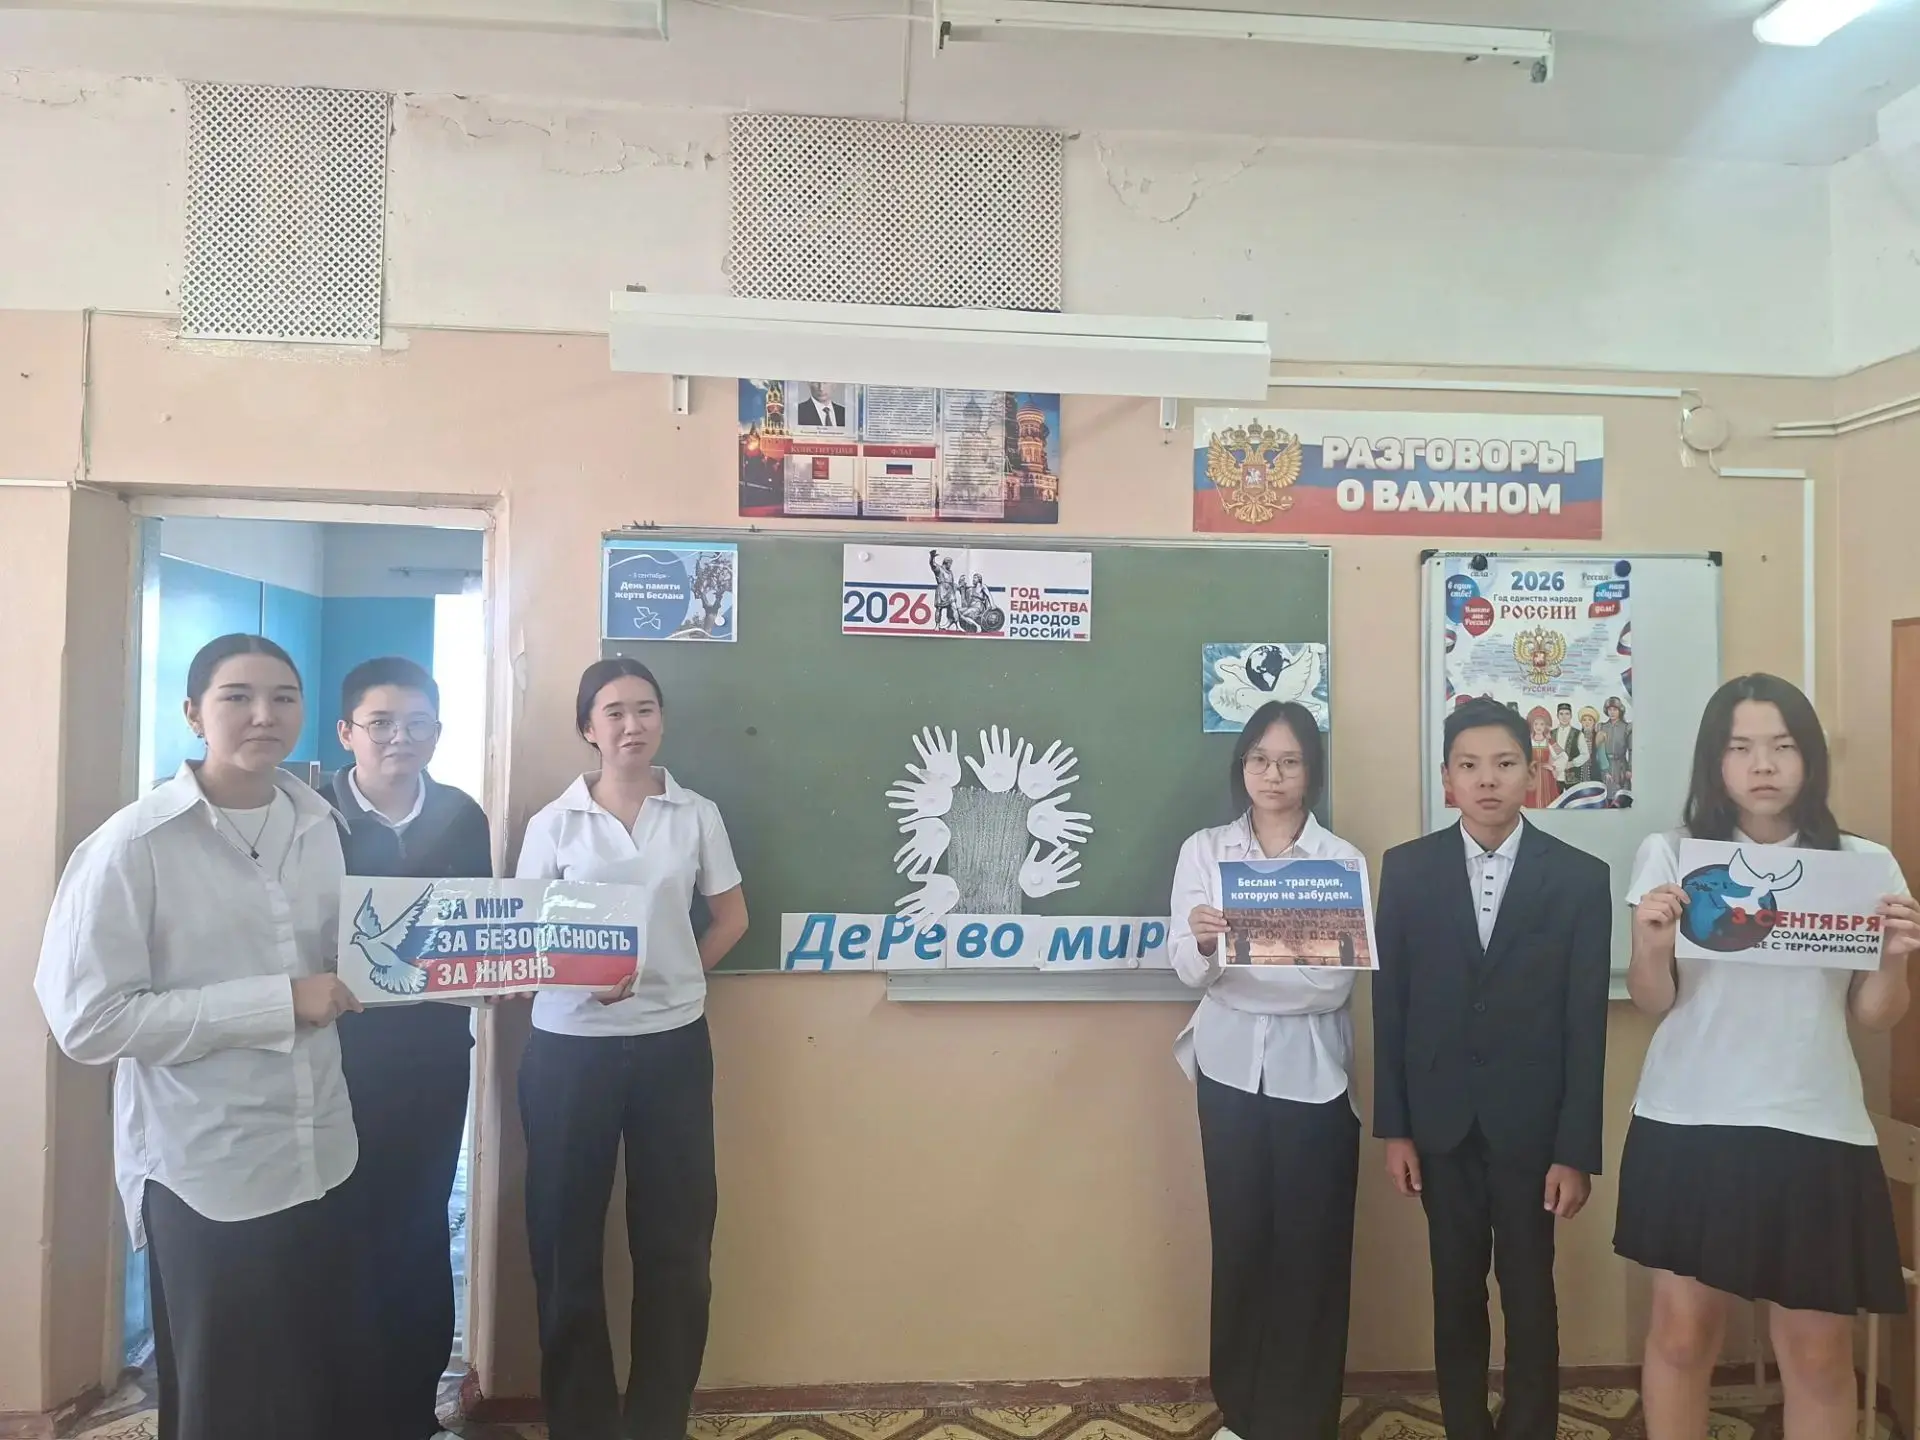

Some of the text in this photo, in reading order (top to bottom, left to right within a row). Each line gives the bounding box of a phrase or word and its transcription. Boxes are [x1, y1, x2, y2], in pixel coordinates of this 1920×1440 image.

[1321, 436, 1576, 474] РАЗГОВОРЫ
[1336, 479, 1561, 515] О ВАЖНОМ
[620, 581, 681, 591] День памяти
[1511, 571, 1565, 591] 2026
[614, 591, 684, 601] жертв Беслана
[1010, 587, 1040, 601] ГОД
[1493, 594, 1508, 602] Год
[843, 591, 932, 625] 2026
[1010, 600, 1088, 613] ЕДИНСТВА
[1500, 604, 1577, 620] РОССИИ
[1009, 614, 1081, 626] НАРОДОВ
[1009, 626, 1071, 639] РОССИИ
[1237, 878, 1276, 887] Беслан
[1285, 878, 1343, 889] трагедия,
[1231, 890, 1353, 902] которую не забудем.
[437, 897, 524, 920] ЗА МИР
[1731, 906, 1881, 932] 3 СЕНТЯБРЯ
[437, 925, 631, 953] ЗА БЕЗОПАСНОСТЬ
[1771, 930, 1880, 943] СОЛИДАРНОСТИ
[1771, 942, 1781, 950] С
[1784, 942, 1879, 954] ТЕРРОРИЗМОМ
[437, 956, 556, 986] ЗА ЖИЗНЬ
